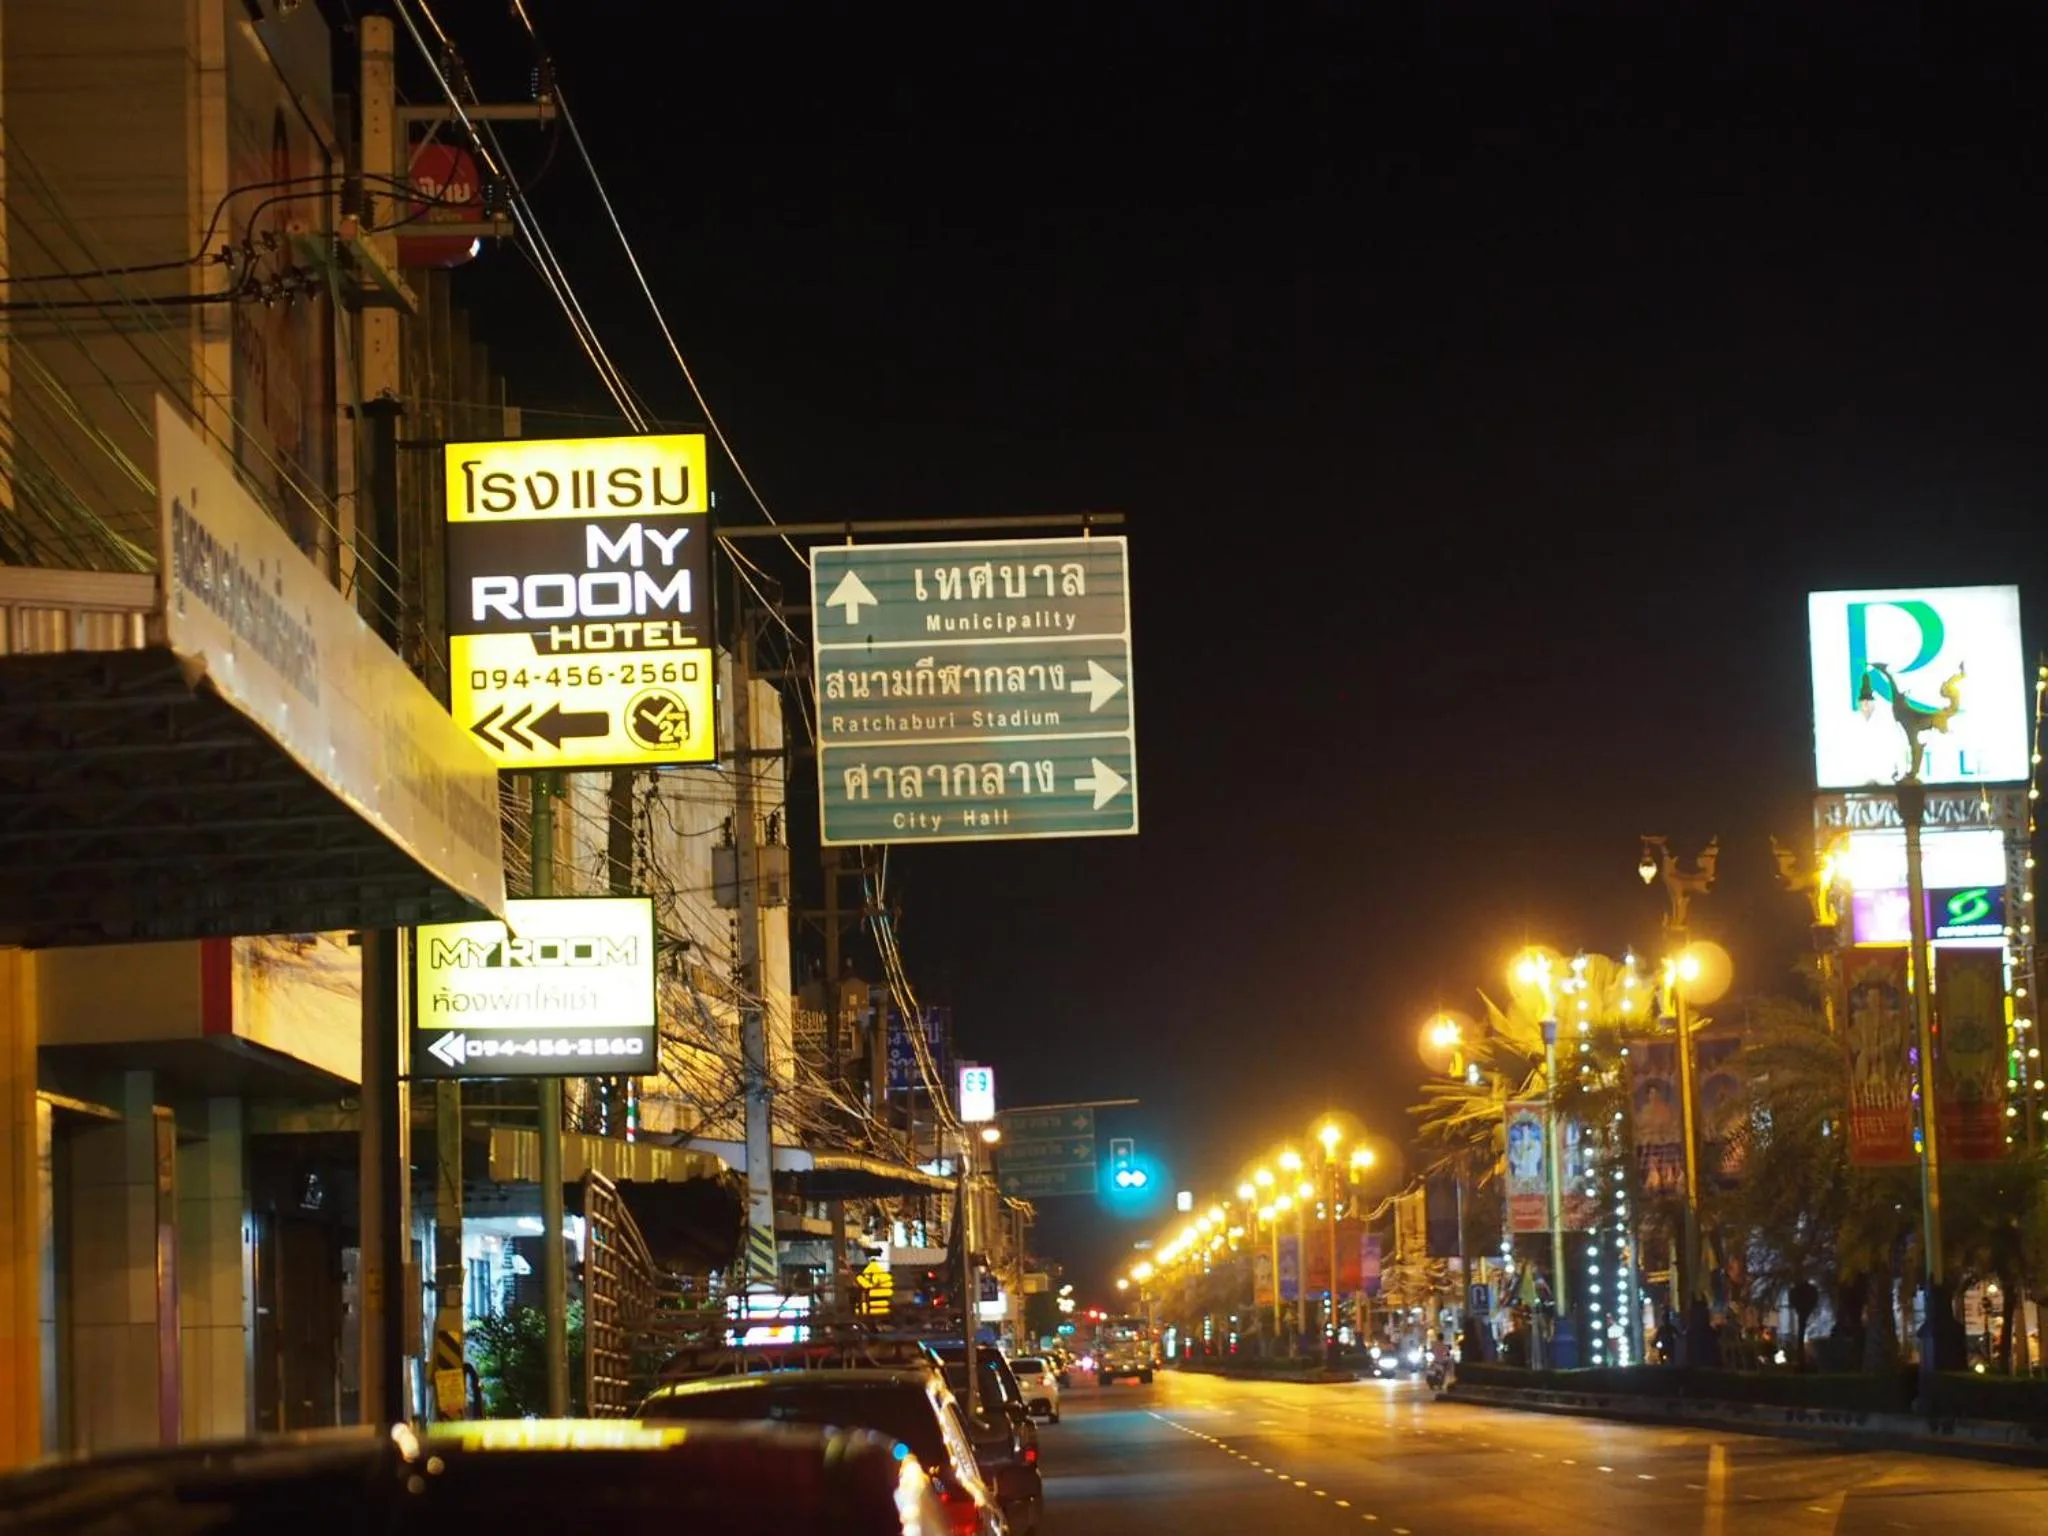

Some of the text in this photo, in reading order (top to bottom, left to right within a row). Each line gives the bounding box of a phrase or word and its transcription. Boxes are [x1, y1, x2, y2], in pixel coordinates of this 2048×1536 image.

[461, 460, 690, 514] โรงแรม
[586, 522, 690, 569] MY
[471, 569, 692, 621] ROOM
[913, 561, 1086, 602] เทศบาล
[551, 620, 698, 651] HOTEL
[926, 612, 1077, 633] Municipality
[471, 662, 699, 690] 094-456-2560
[825, 656, 1066, 699] สนามกีฬากลาง
[658, 719, 689, 743] 24
[832, 709, 1061, 734] Ratchaburi Stadium
[843, 760, 1055, 801] ศาลากลาง
[893, 808, 1010, 832] City Hall
